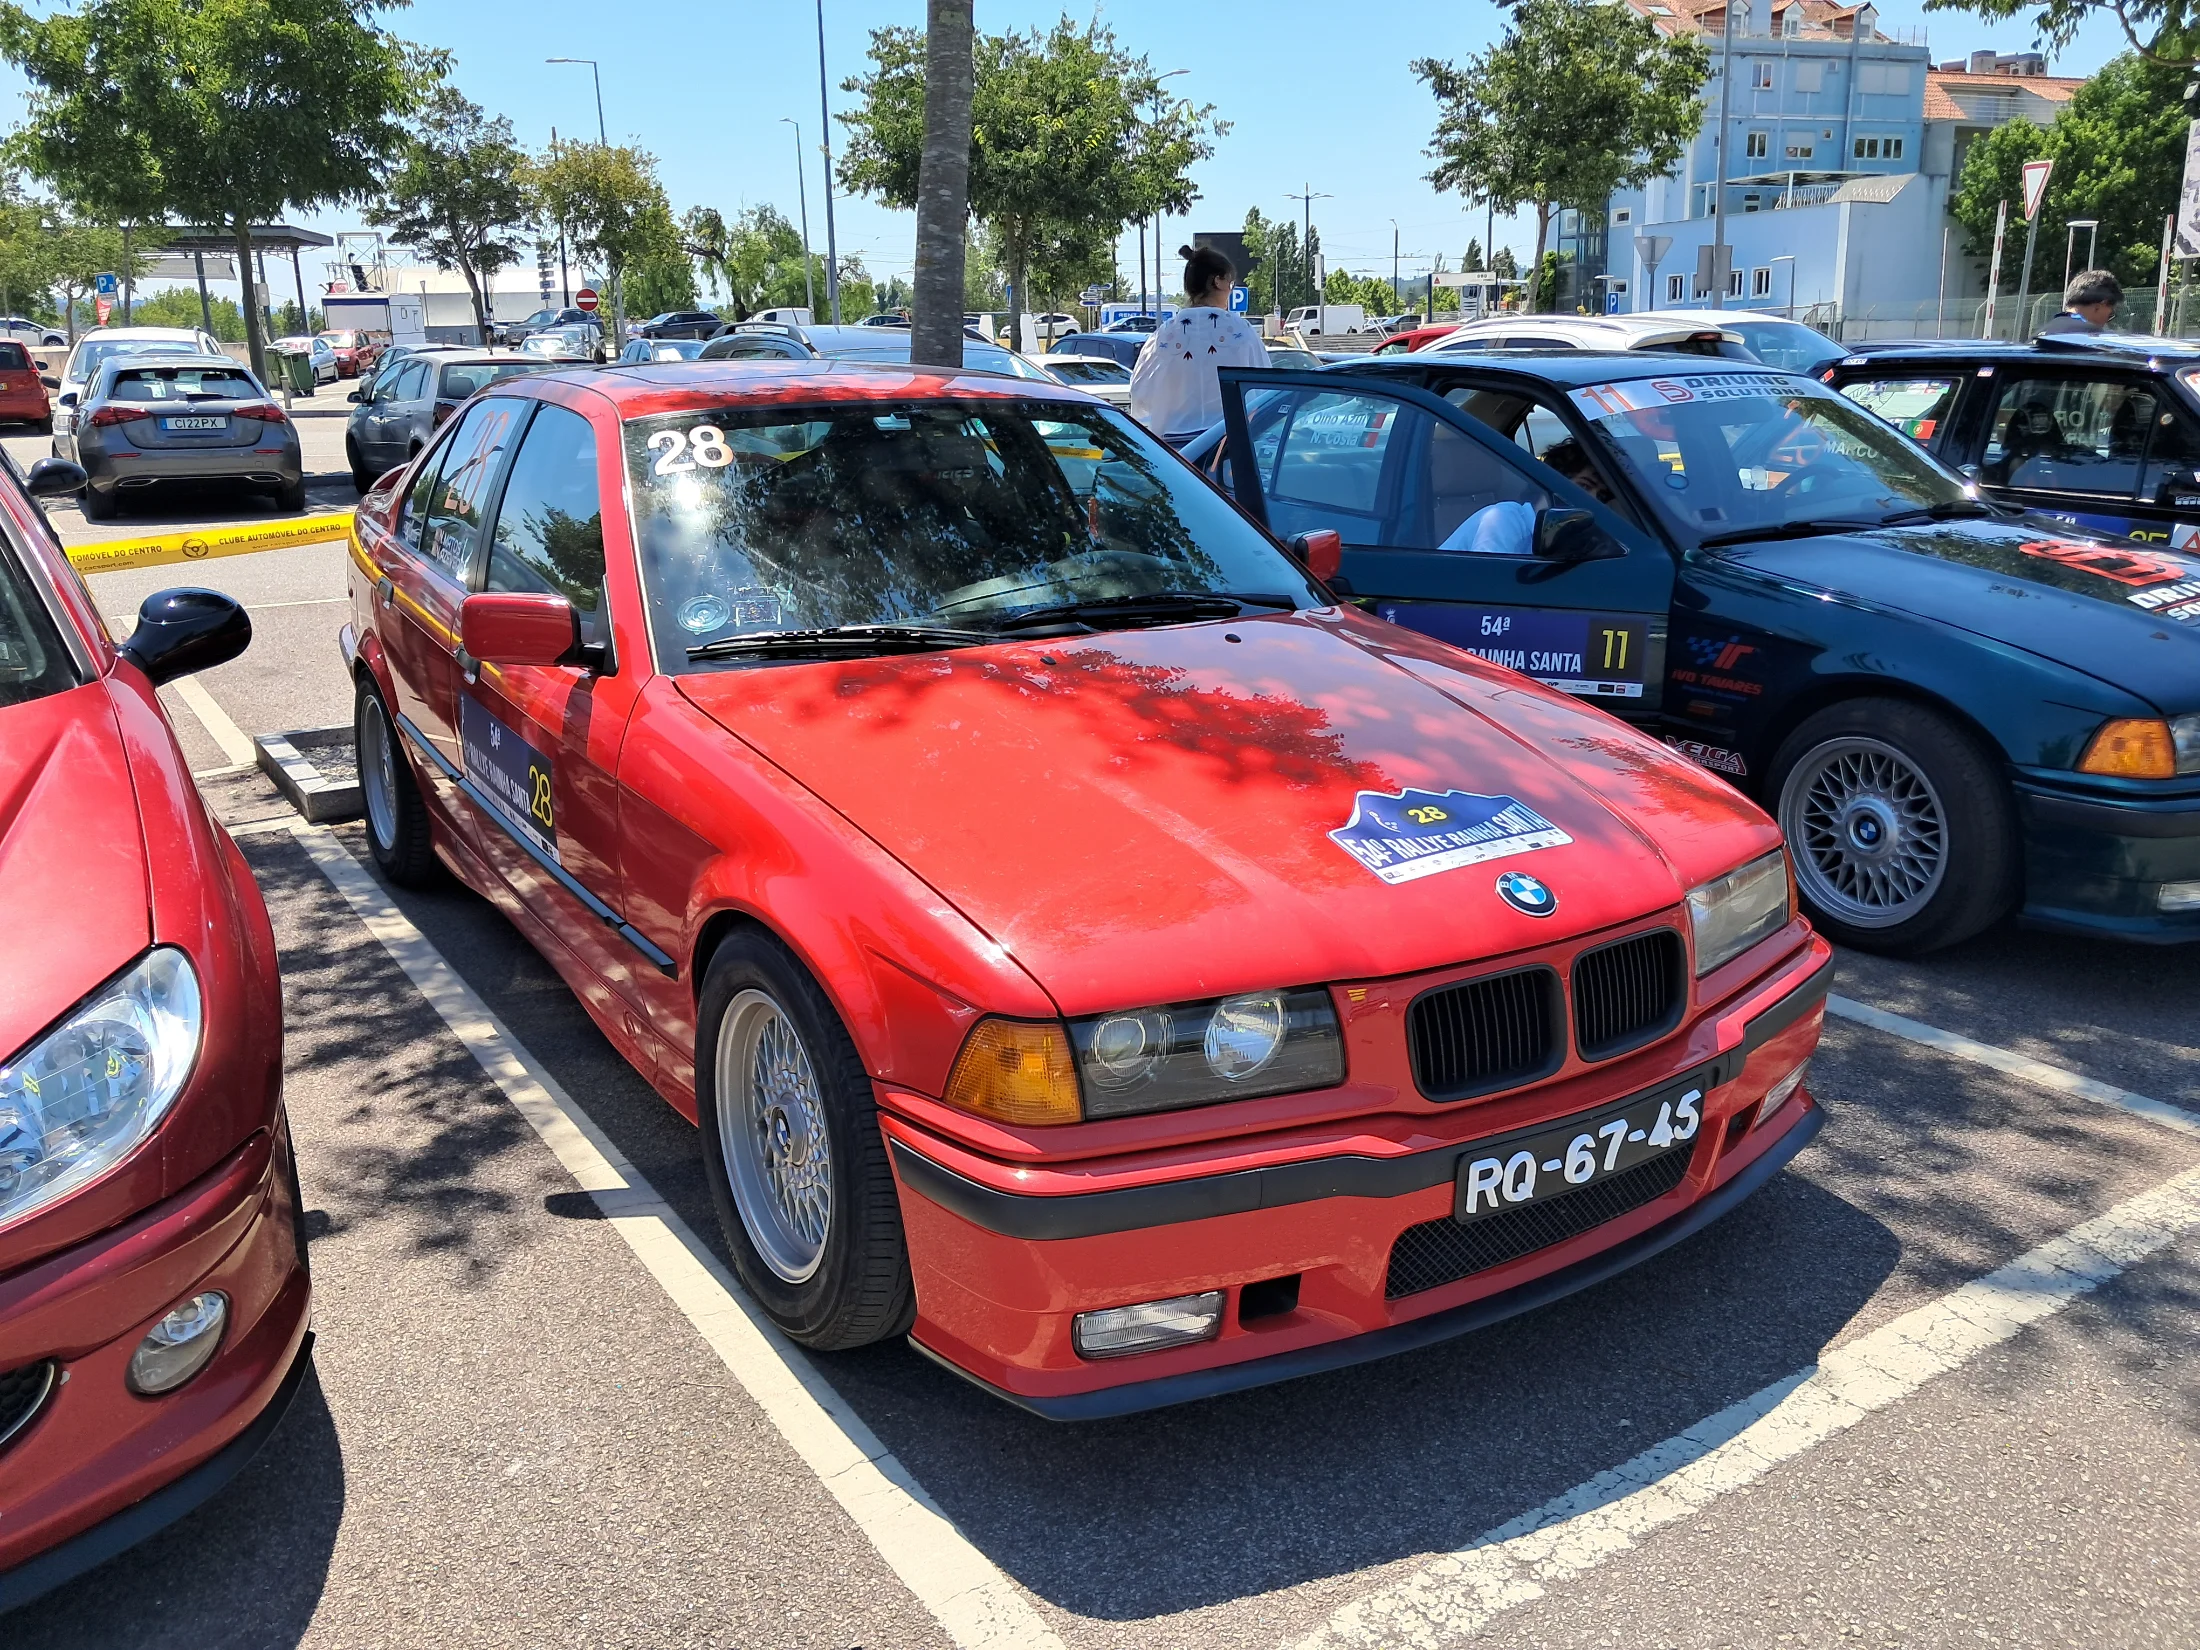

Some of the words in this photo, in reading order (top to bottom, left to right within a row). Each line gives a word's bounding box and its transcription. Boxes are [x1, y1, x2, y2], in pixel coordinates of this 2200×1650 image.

[1232, 289, 1244, 309] P
[1610, 294, 1617, 311] P
[1581, 384, 1634, 414] 11
[1684, 375, 1789, 388] DRIVING
[1700, 387, 1806, 400] SOLUTIONS
[174, 417, 218, 429] CI22PX
[444, 410, 510, 514] 28
[647, 425, 734, 476] 28
[219, 535, 246, 546] CLUBE
[247, 529, 296, 542] AUTOMÓVEL
[297, 527, 308, 536] DO
[309, 523, 341, 534] CENTRO
[114, 549, 126, 558] DO
[128, 545, 162, 556] CENTRO
[1530, 651, 1582, 674] SANTA
[1602, 630, 1629, 670] 11
[1701, 674, 1763, 696] TAVARES
[1666, 735, 1747, 776] VEIGA
[510, 778, 533, 818] SANTA
[529, 764, 553, 828] 28
[1407, 806, 1449, 824] 28
[1381, 834, 1455, 860] RALLYE
[1445, 821, 1504, 847] RAINHA
[1491, 803, 1554, 834] SANTA
[1465, 1089, 1702, 1214] RQ-67-45
